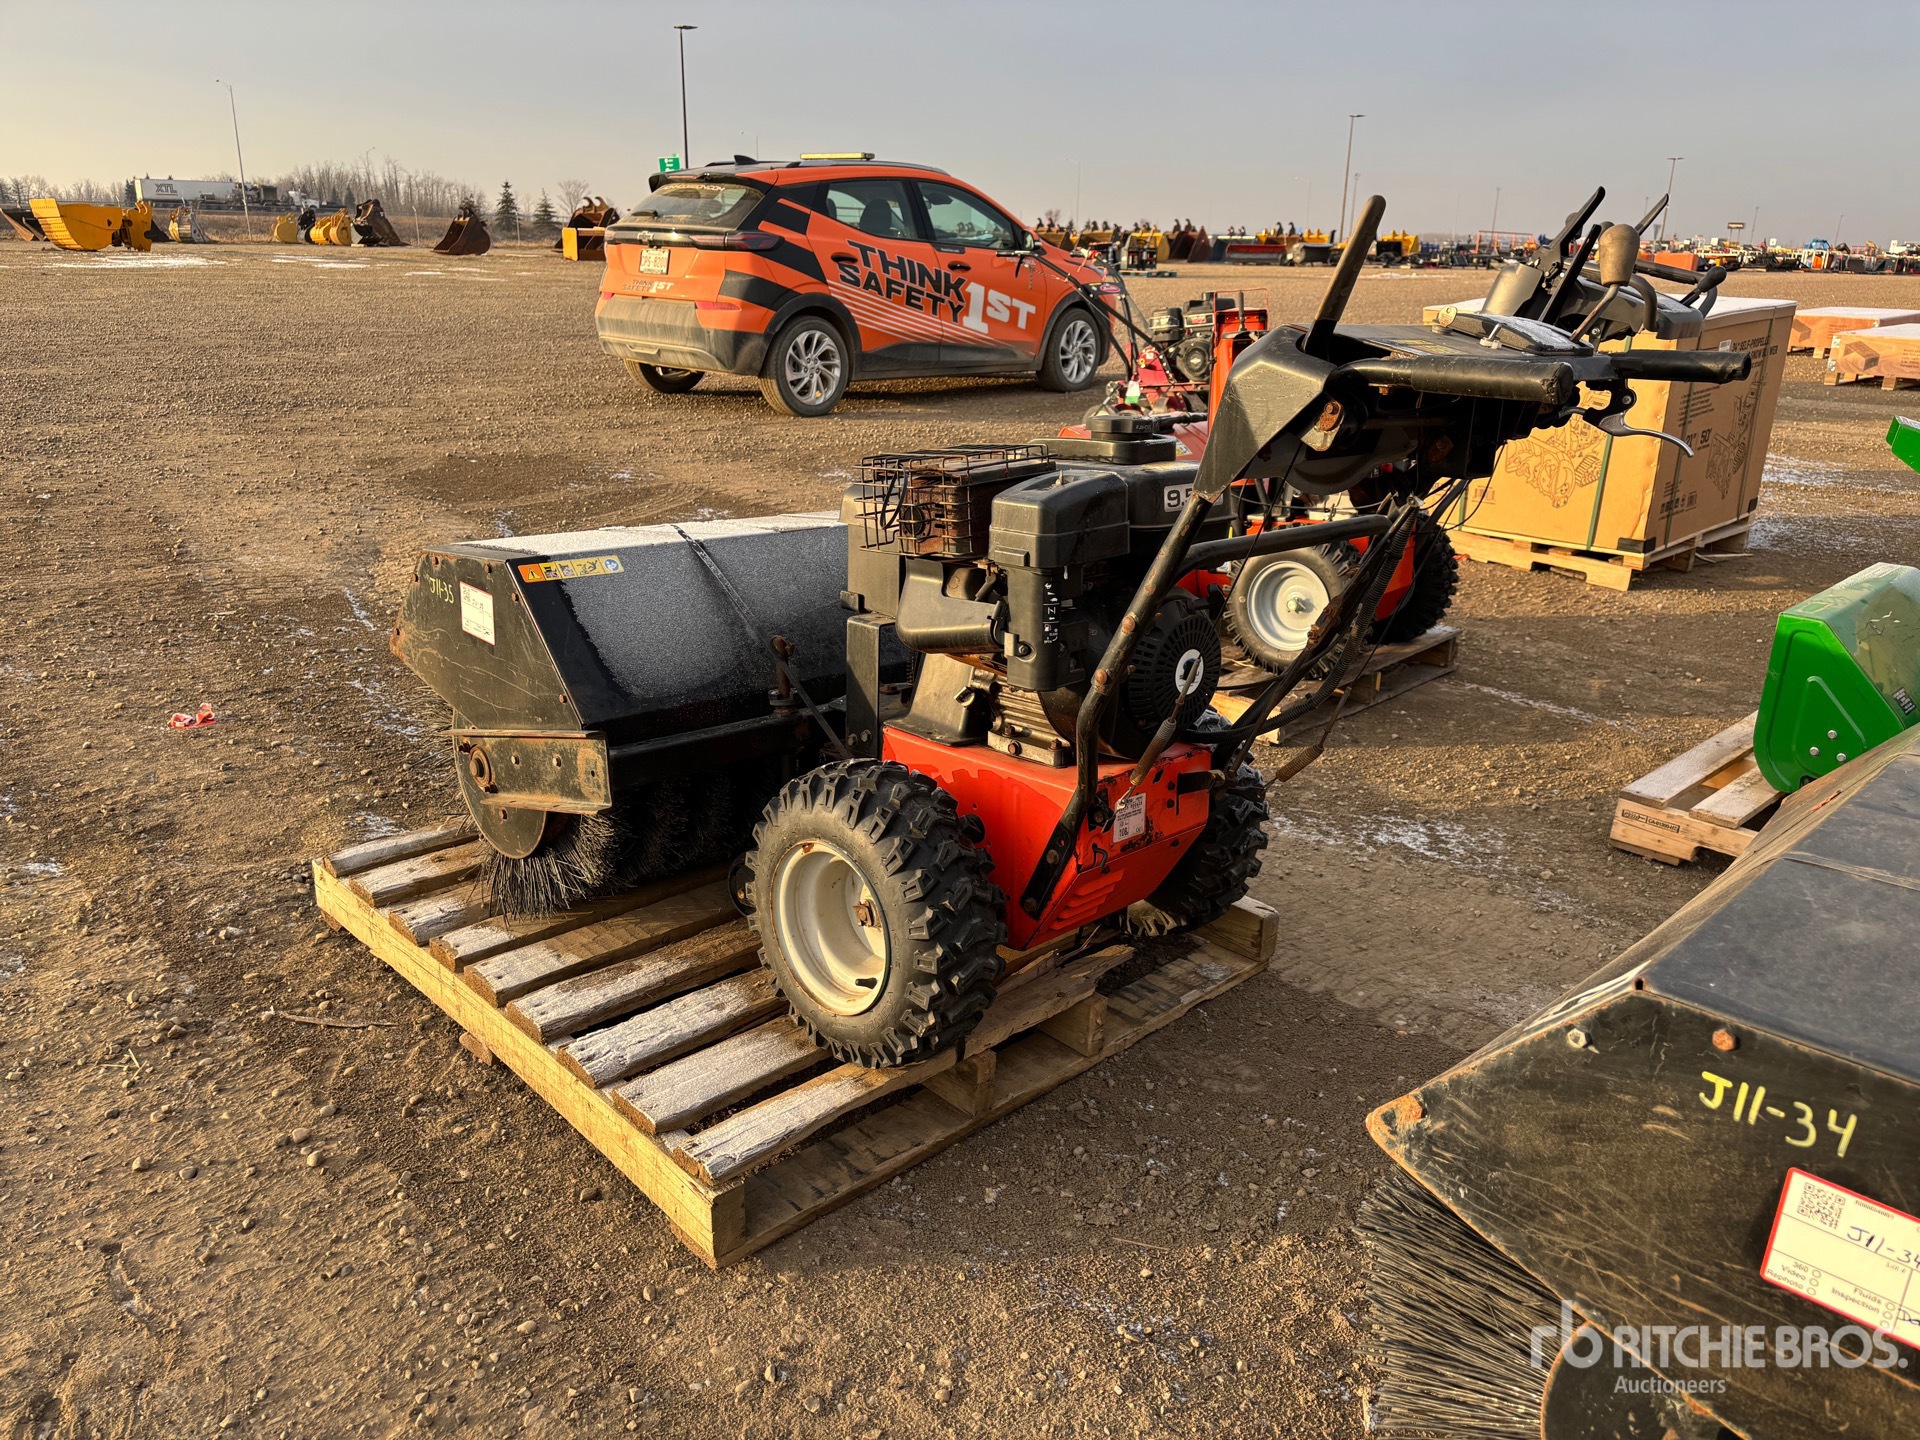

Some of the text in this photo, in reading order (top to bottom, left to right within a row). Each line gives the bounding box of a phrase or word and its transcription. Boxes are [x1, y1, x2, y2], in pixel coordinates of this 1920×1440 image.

[155, 183, 177, 193] XTL
[847, 239, 966, 303] THINK
[622, 281, 674, 293] SAFETY 1ST
[632, 279, 654, 287] THINK
[837, 263, 1036, 334] SAFETY 1ST
[430, 577, 454, 603] J11-35
[1699, 1071, 1857, 1158] J11-34
[1767, 1269, 1804, 1289] Rephoto
[1781, 1264, 1806, 1281] Video
[1831, 1287, 1880, 1314] Inspection
[1853, 1287, 1882, 1305] Fluids
